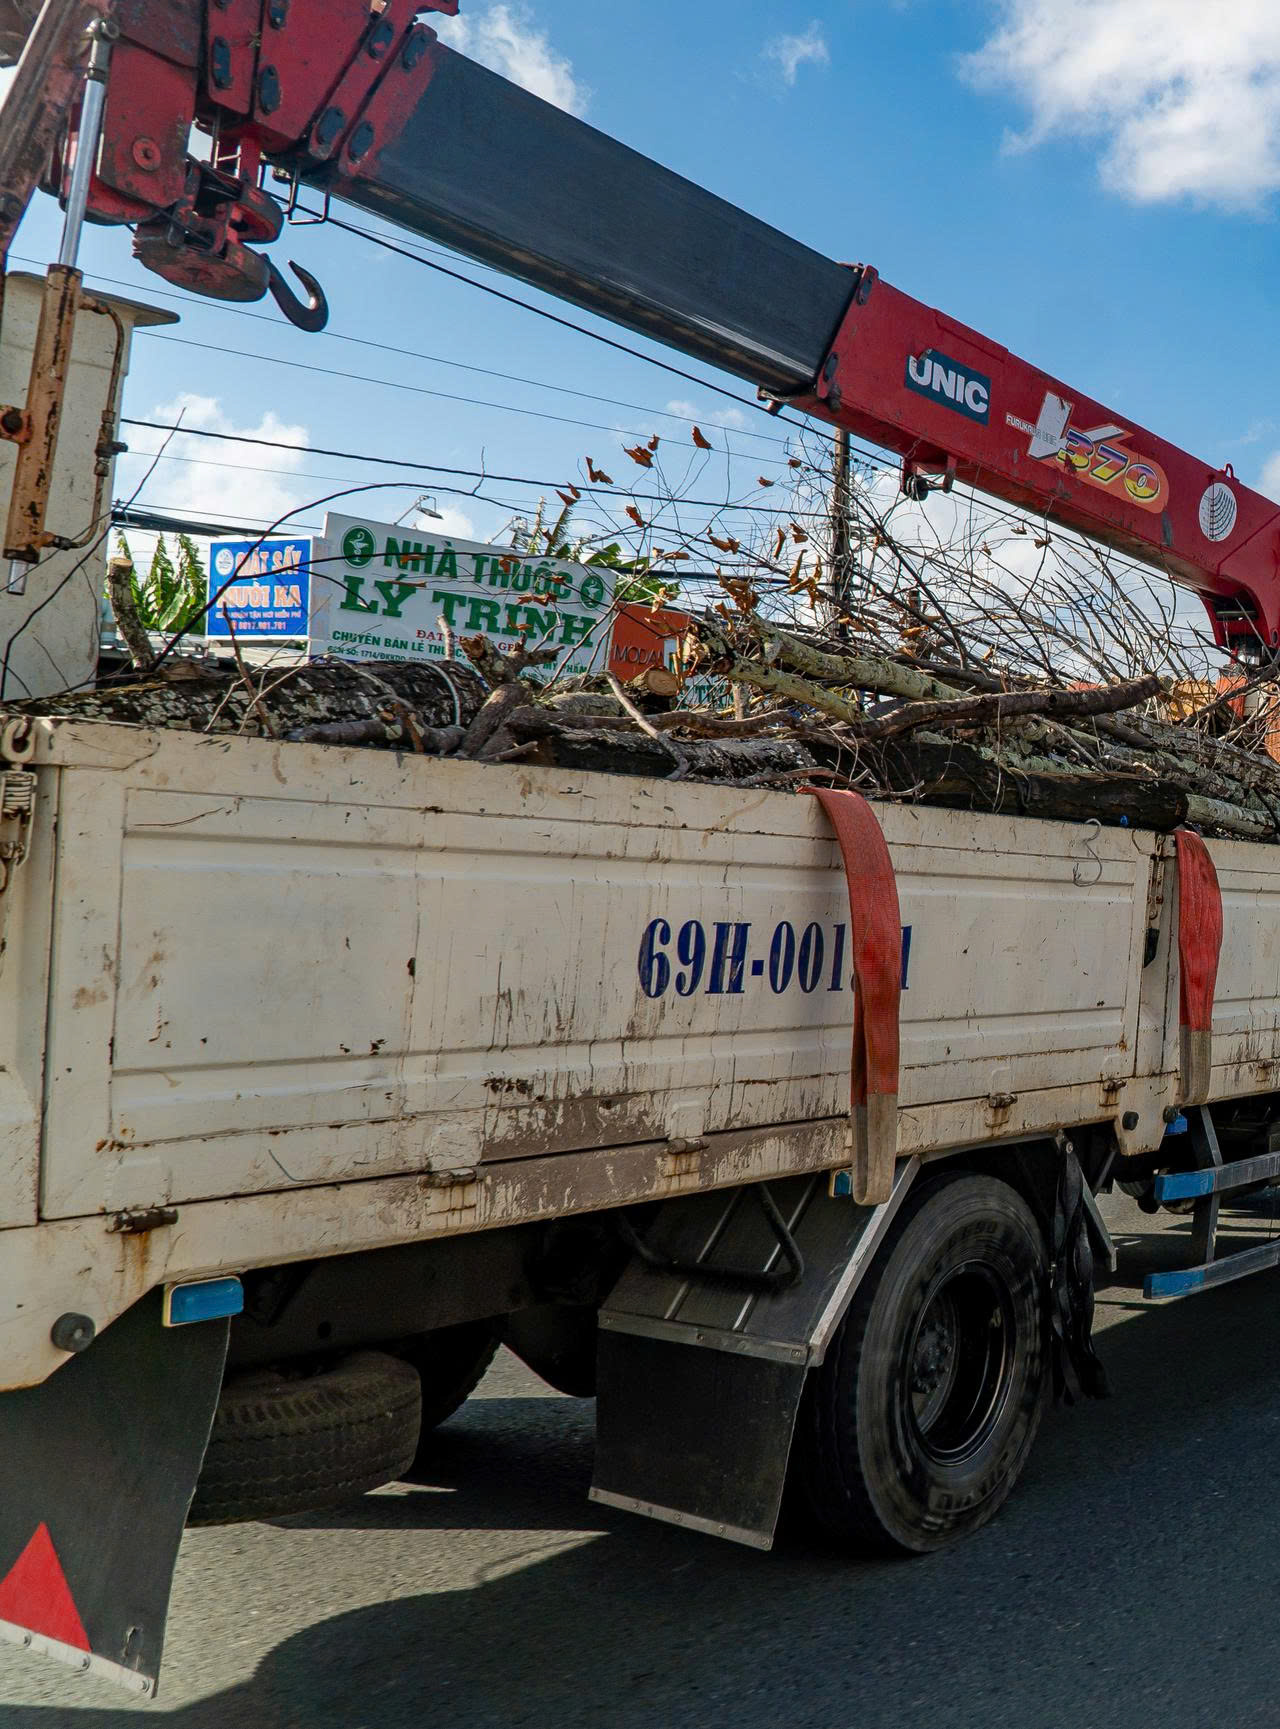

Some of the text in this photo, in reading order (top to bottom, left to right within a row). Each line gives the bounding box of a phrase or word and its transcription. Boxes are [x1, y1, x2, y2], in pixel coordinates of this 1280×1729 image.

[909, 356, 989, 414] UNIC
[383, 536, 574, 600] NHÀ THUỐC
[332, 630, 381, 646] CHUYÊN
[384, 637, 409, 650] BÁN
[340, 573, 597, 648] LÝ TRINH
